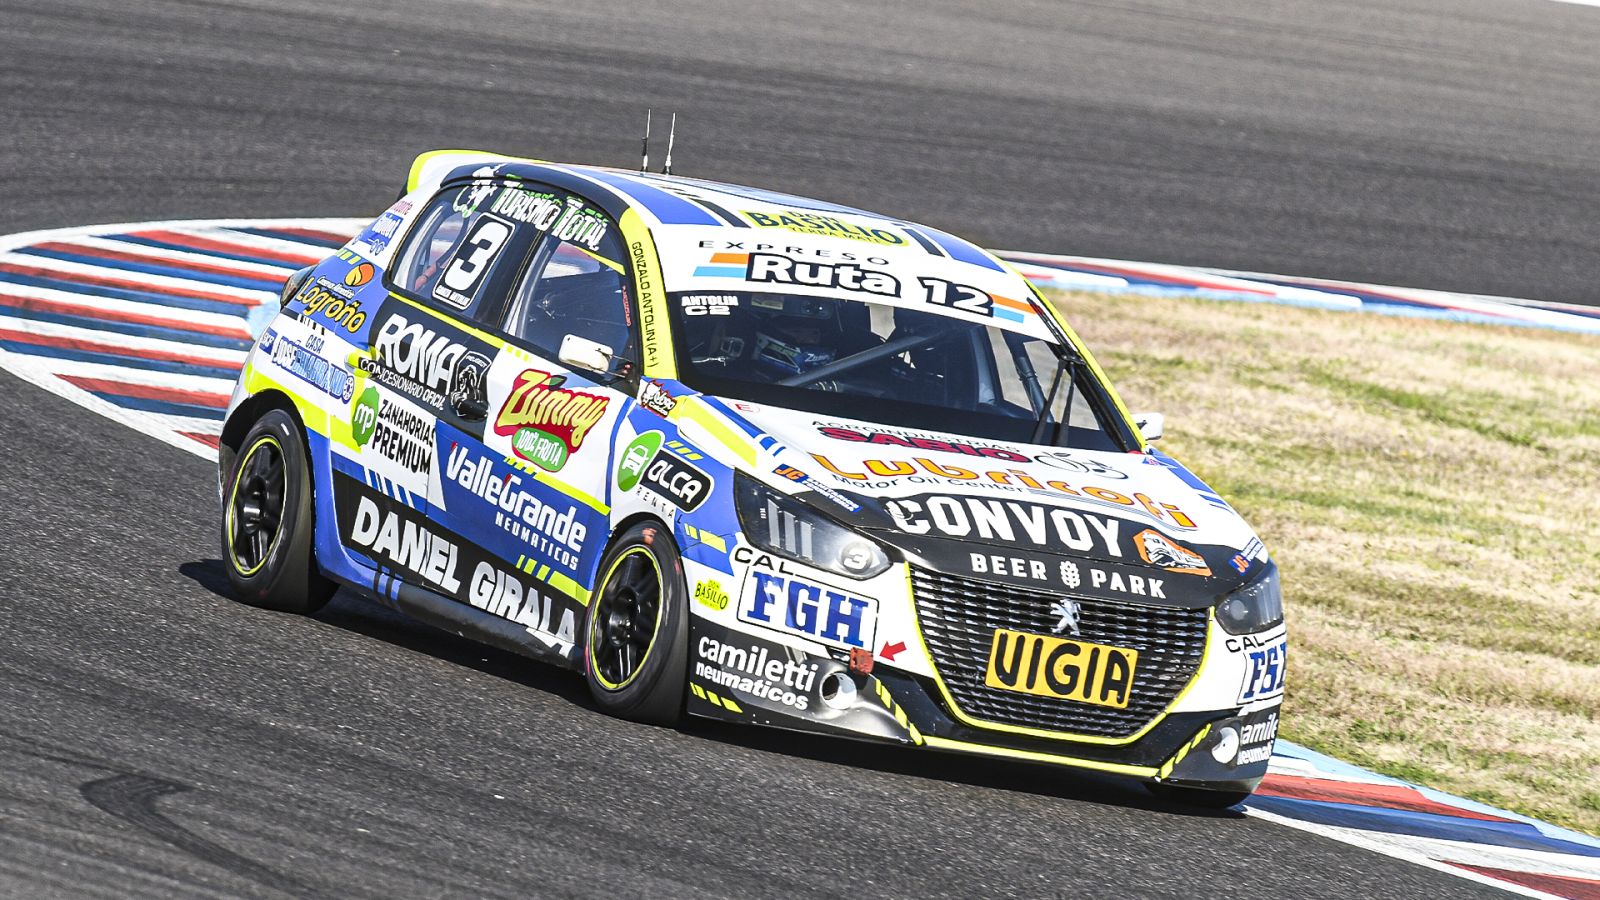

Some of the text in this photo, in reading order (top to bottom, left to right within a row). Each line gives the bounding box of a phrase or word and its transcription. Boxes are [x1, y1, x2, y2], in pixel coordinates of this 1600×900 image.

[490, 181, 606, 251] TURISMO TOTAL
[745, 211, 904, 244] BASILIO
[443, 221, 509, 291] 3
[699, 240, 888, 266] EXPRESO
[843, 233, 881, 244] MATE
[296, 277, 367, 333] Logroño
[632, 241, 650, 290] GONZALO
[642, 292, 656, 342] ANTOLIN
[681, 295, 739, 307] ANTOLIN
[748, 254, 993, 317] Ruta 12
[685, 305, 731, 316] C2
[305, 334, 325, 354] CASA
[374, 313, 468, 395] ROMA
[360, 358, 424, 399] CONCESIONARIO
[378, 399, 436, 448] ZANAHORIAS
[497, 370, 610, 447] Zummy
[372, 421, 432, 475] PREMIUM
[533, 437, 563, 467] FRUTA
[812, 420, 1021, 453] AGROINDUSTRIAS
[817, 427, 1033, 463] SABIO
[775, 466, 806, 481] JC
[832, 473, 1024, 494] Motor Oil Center
[446, 442, 587, 553] ValleGrande
[636, 487, 683, 525] RENTAL
[351, 496, 461, 594] DANIEL
[495, 511, 580, 571] NEUMATICOS
[884, 496, 1122, 558] CONVOY
[735, 547, 794, 576] CAL
[843, 547, 871, 569] 3
[970, 552, 1167, 599] BEER PARK
[695, 582, 728, 610] BASILIO
[747, 571, 869, 647] FGH
[698, 637, 818, 693] camiletti
[1225, 635, 1265, 653] CAL
[696, 661, 809, 710] neumaticos
